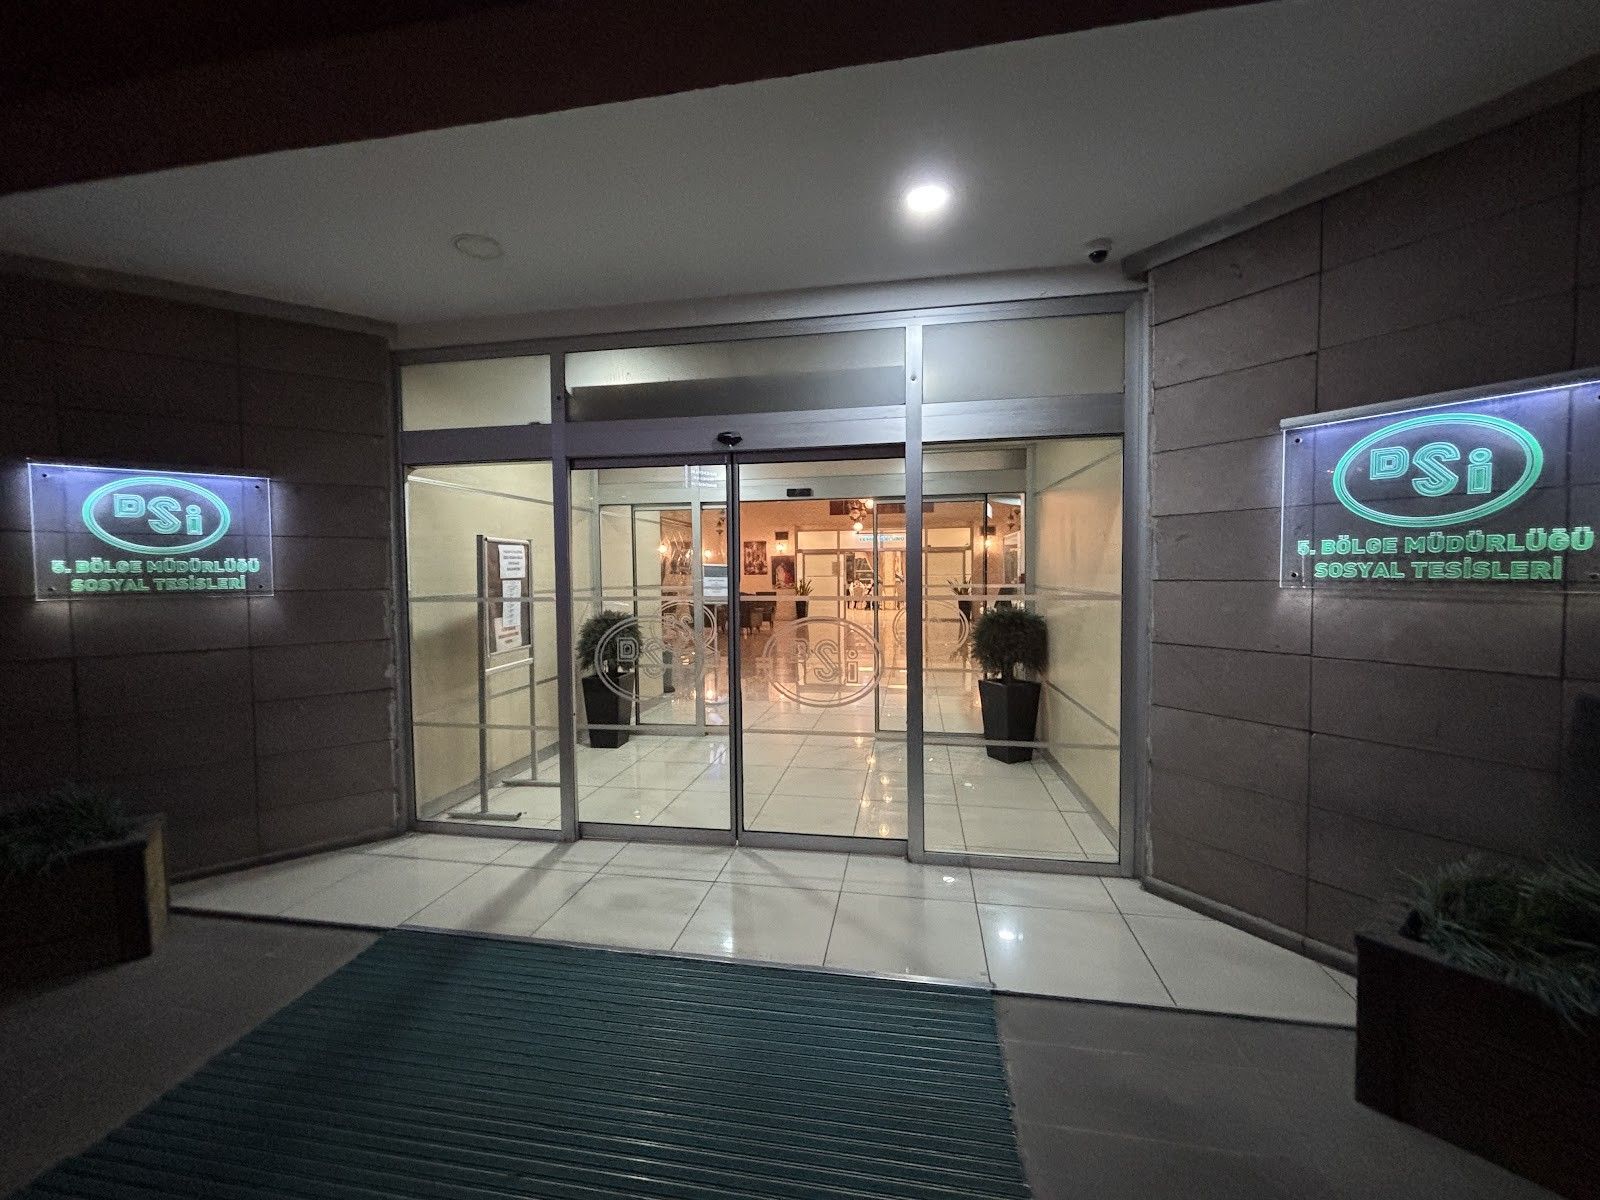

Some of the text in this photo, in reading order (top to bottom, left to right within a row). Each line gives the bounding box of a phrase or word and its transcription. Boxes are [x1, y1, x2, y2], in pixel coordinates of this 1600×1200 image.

[1297, 527, 1594, 556] 5. BÖLGE MÜDÜRLÜĞÜ
[51, 557, 260, 573] 5. BÖLGE MÜDÜRLÜĞÜ
[1314, 556, 1564, 580] SOSYAL TESİSLERİ
[70, 575, 246, 592] SOSYAL TESİSLERİ
